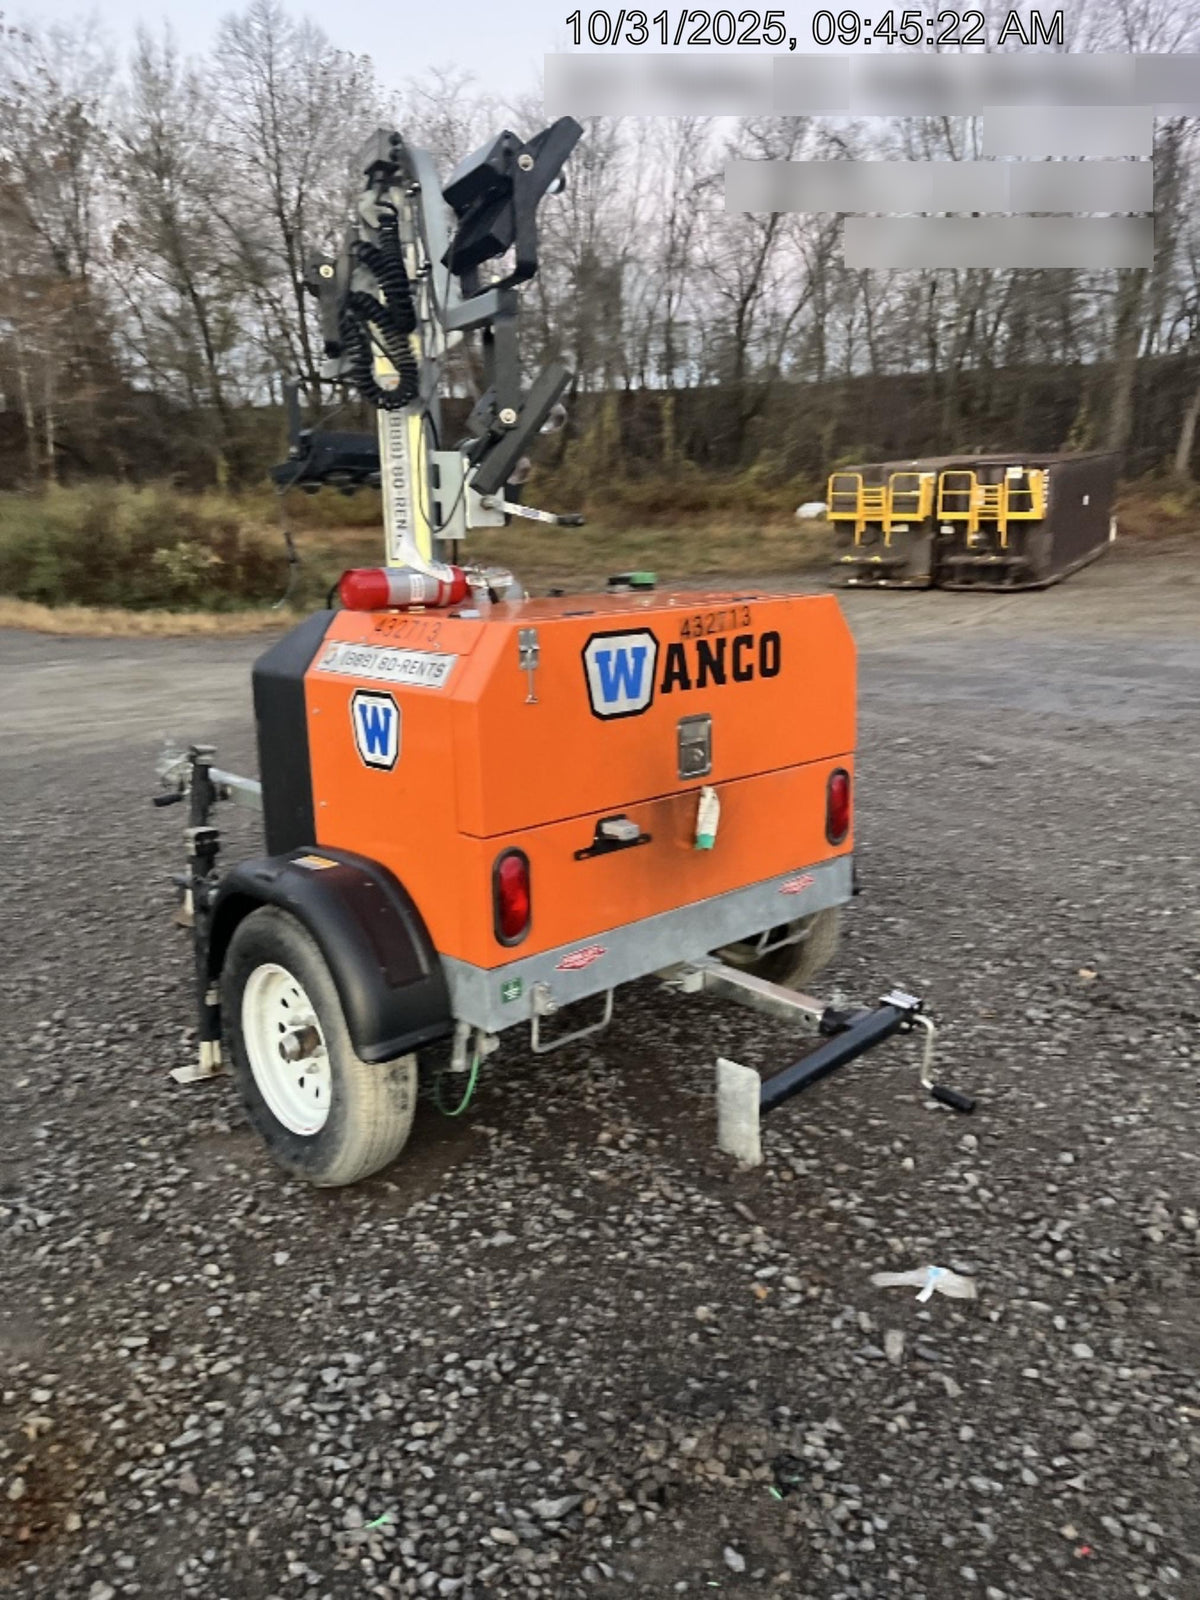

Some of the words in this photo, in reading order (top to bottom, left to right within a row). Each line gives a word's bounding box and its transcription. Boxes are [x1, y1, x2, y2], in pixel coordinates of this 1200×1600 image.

[680, 605, 751, 638] 432713
[594, 630, 782, 704] WANCO
[358, 703, 392, 757] W
